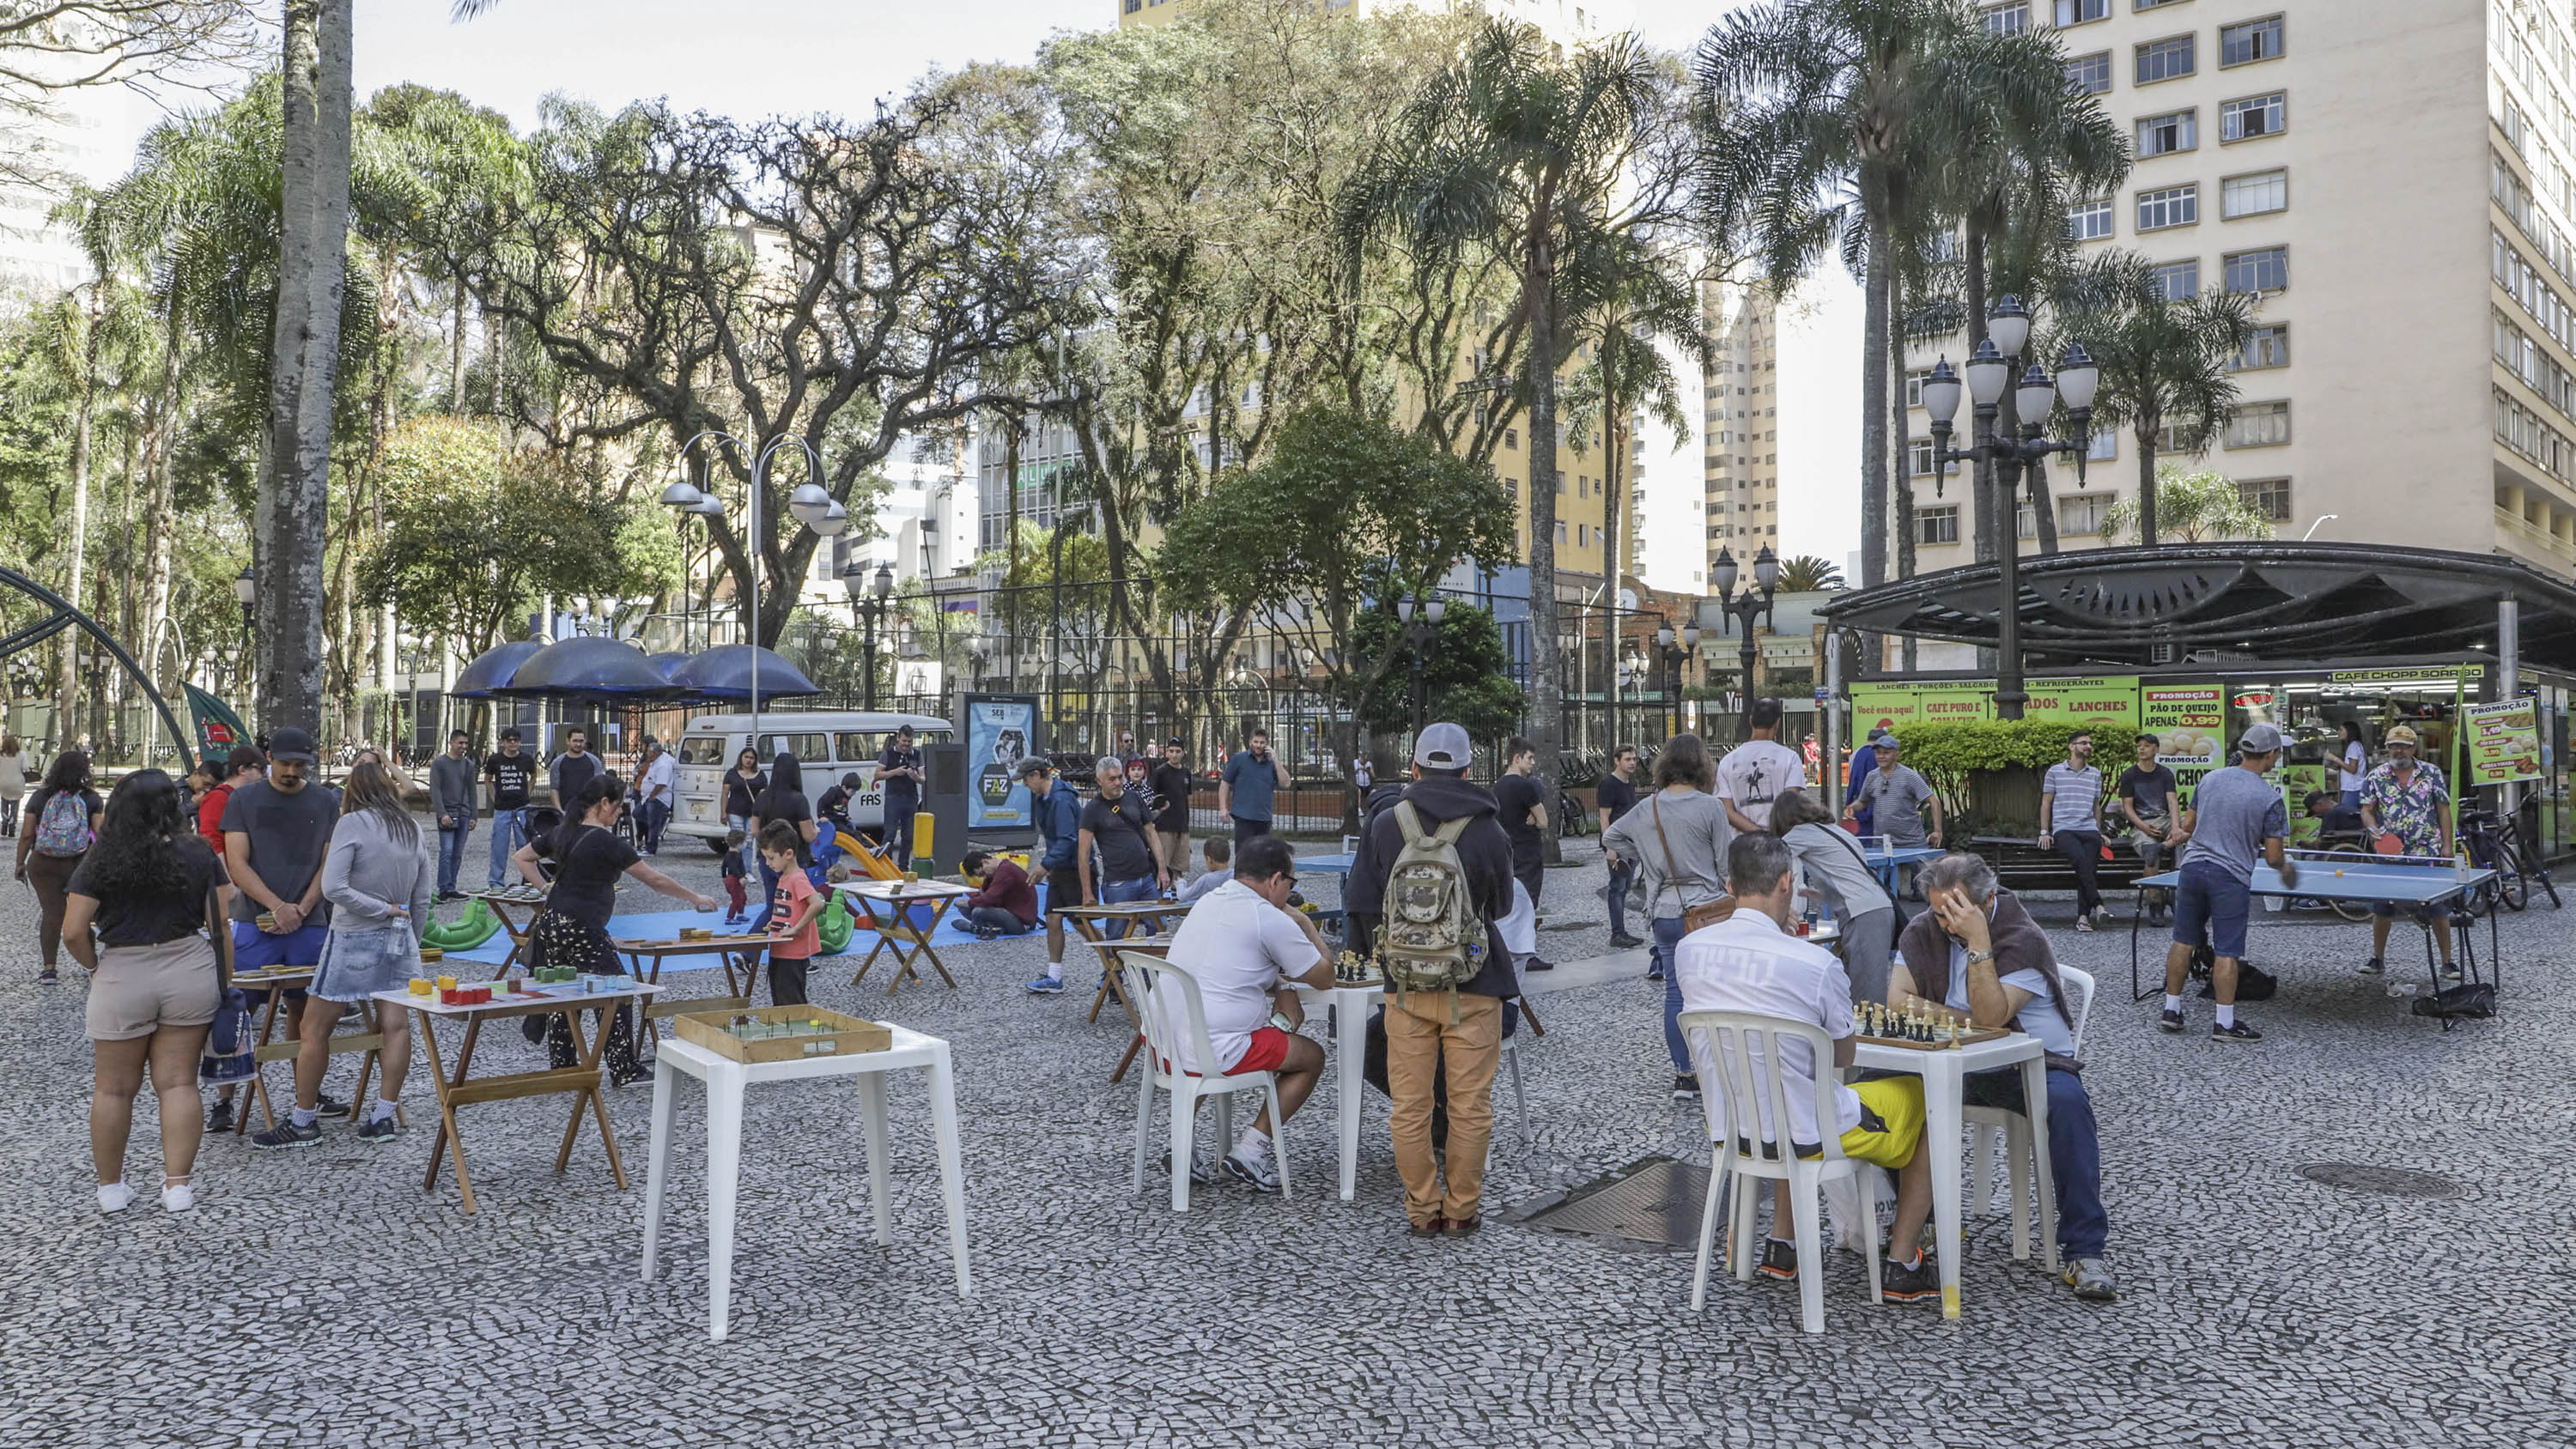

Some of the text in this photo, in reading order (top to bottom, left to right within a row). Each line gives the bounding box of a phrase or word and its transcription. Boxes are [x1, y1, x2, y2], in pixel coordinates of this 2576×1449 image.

[2335, 669, 2482, 681] CAFÉ CHOPP SORRSO
[1917, 682, 1953, 690] PORÇÕES
[2152, 691, 2215, 700] PROMOÇÃO
[2234, 694, 2275, 706] ABERTO
[1857, 705, 1874, 714] Você
[1894, 705, 1915, 717] aqui!
[1926, 700, 1981, 712] CAFÉ PURO E
[2069, 700, 2128, 712] LANCHES
[2150, 703, 2218, 713] PÃO DE QUEIJO
[2470, 700, 2529, 715] PROMOÇÃO
[2145, 716, 2221, 727] APENAS 0,99
[2482, 726, 2501, 736] 1,49
[983, 779, 1008, 793] FAZ
[860, 794, 881, 807] FAS
